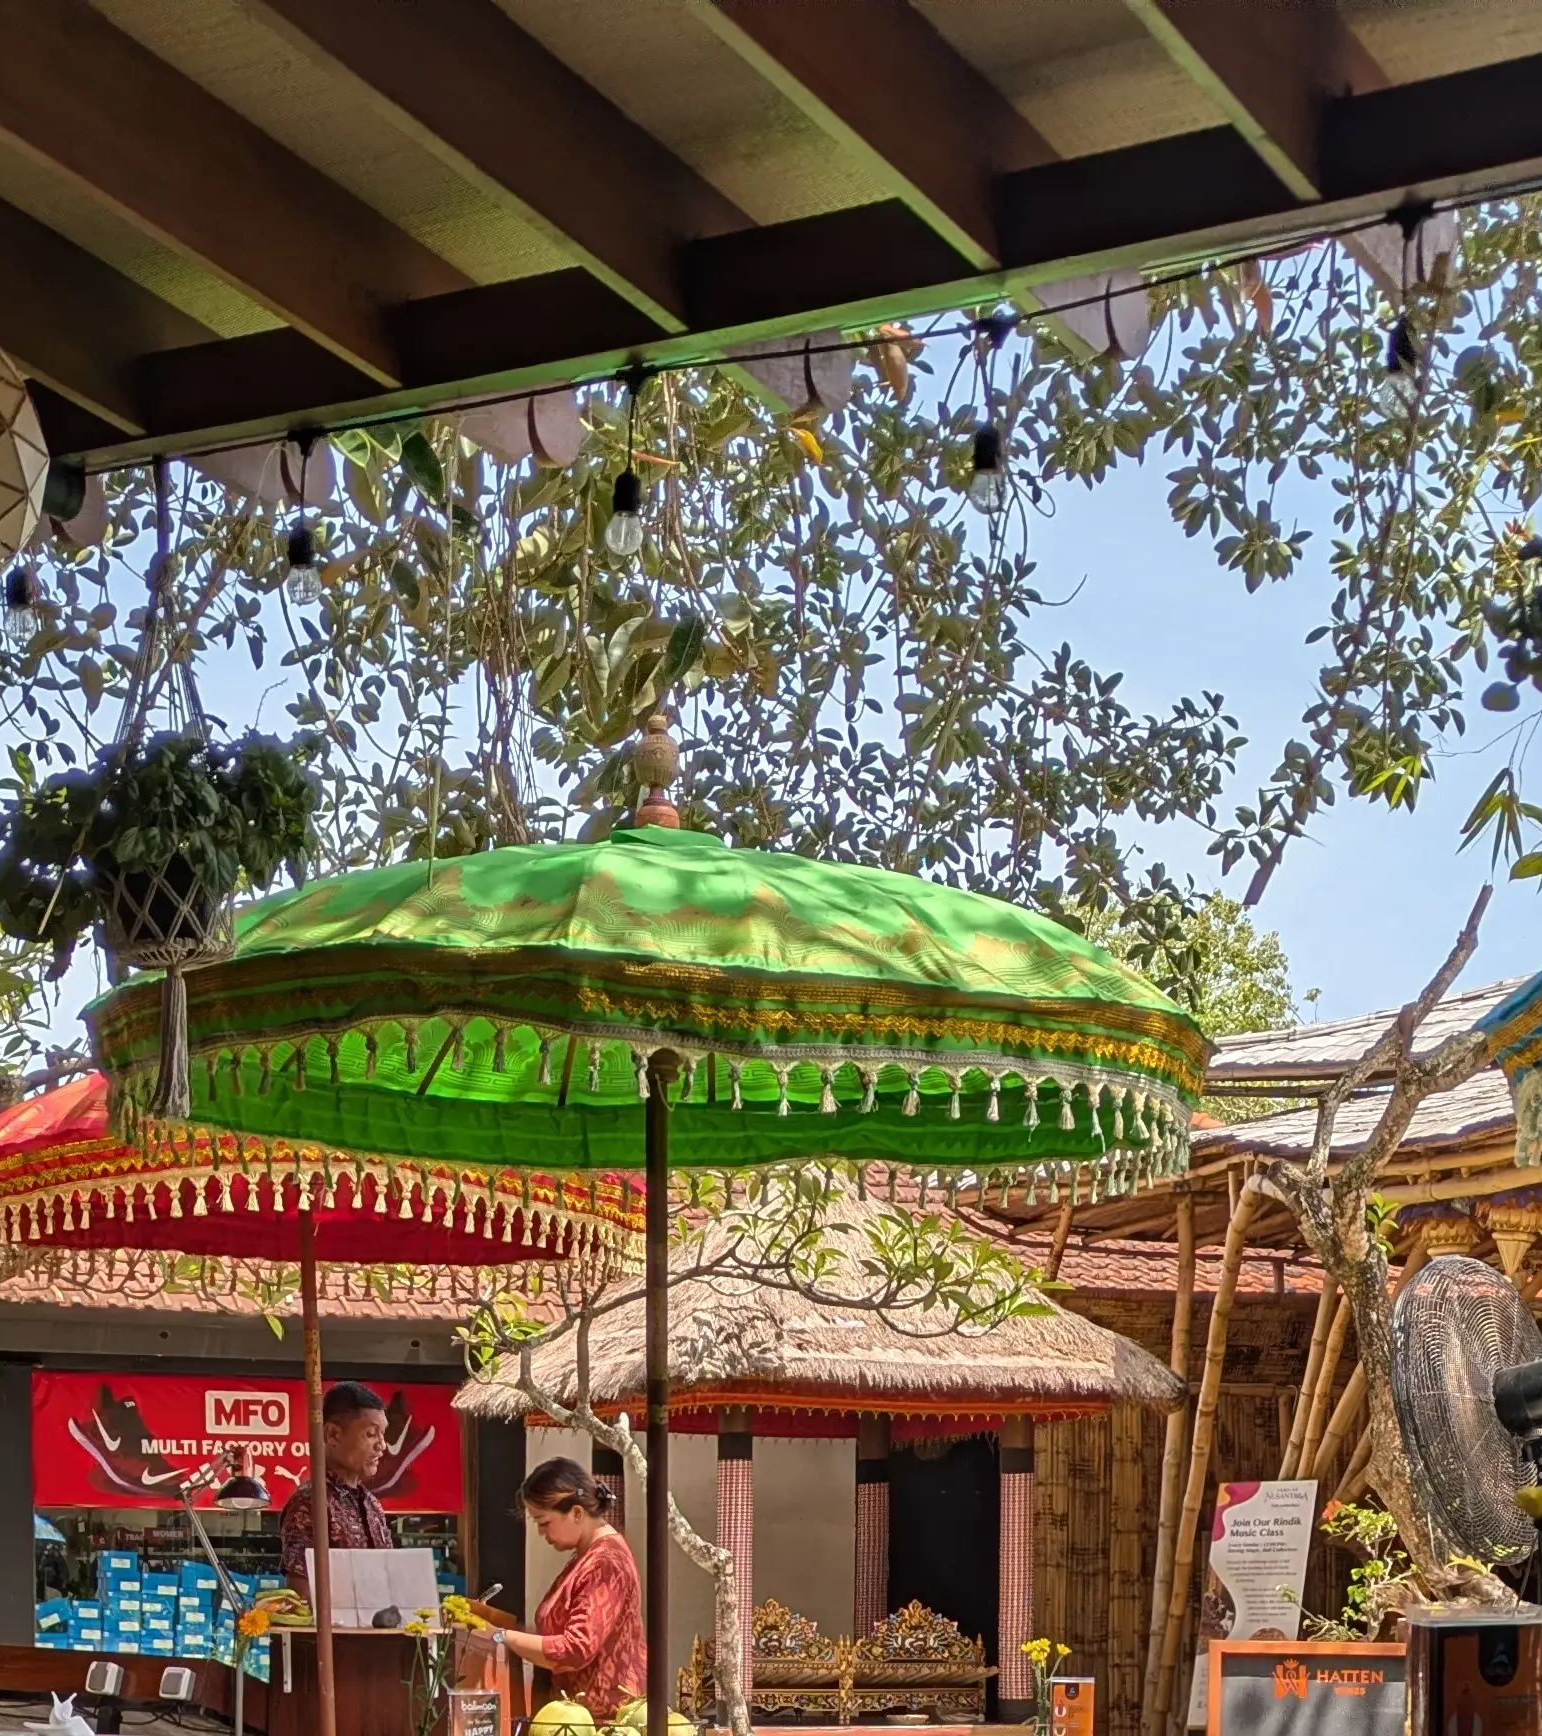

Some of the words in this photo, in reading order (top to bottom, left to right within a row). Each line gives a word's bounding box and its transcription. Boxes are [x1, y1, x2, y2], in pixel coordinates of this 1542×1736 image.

[214, 1398, 286, 1427] MFO
[141, 1439, 197, 1455] MULTI
[1231, 1518, 1251, 1527] Join
[1253, 1518, 1271, 1527] Our
[1273, 1516, 1302, 1526] Rindik
[152, 1530, 183, 1539] WOMEN
[1230, 1528, 1257, 1537] Music
[1259, 1527, 1284, 1537] Class
[1316, 1669, 1384, 1684] HATTEN
